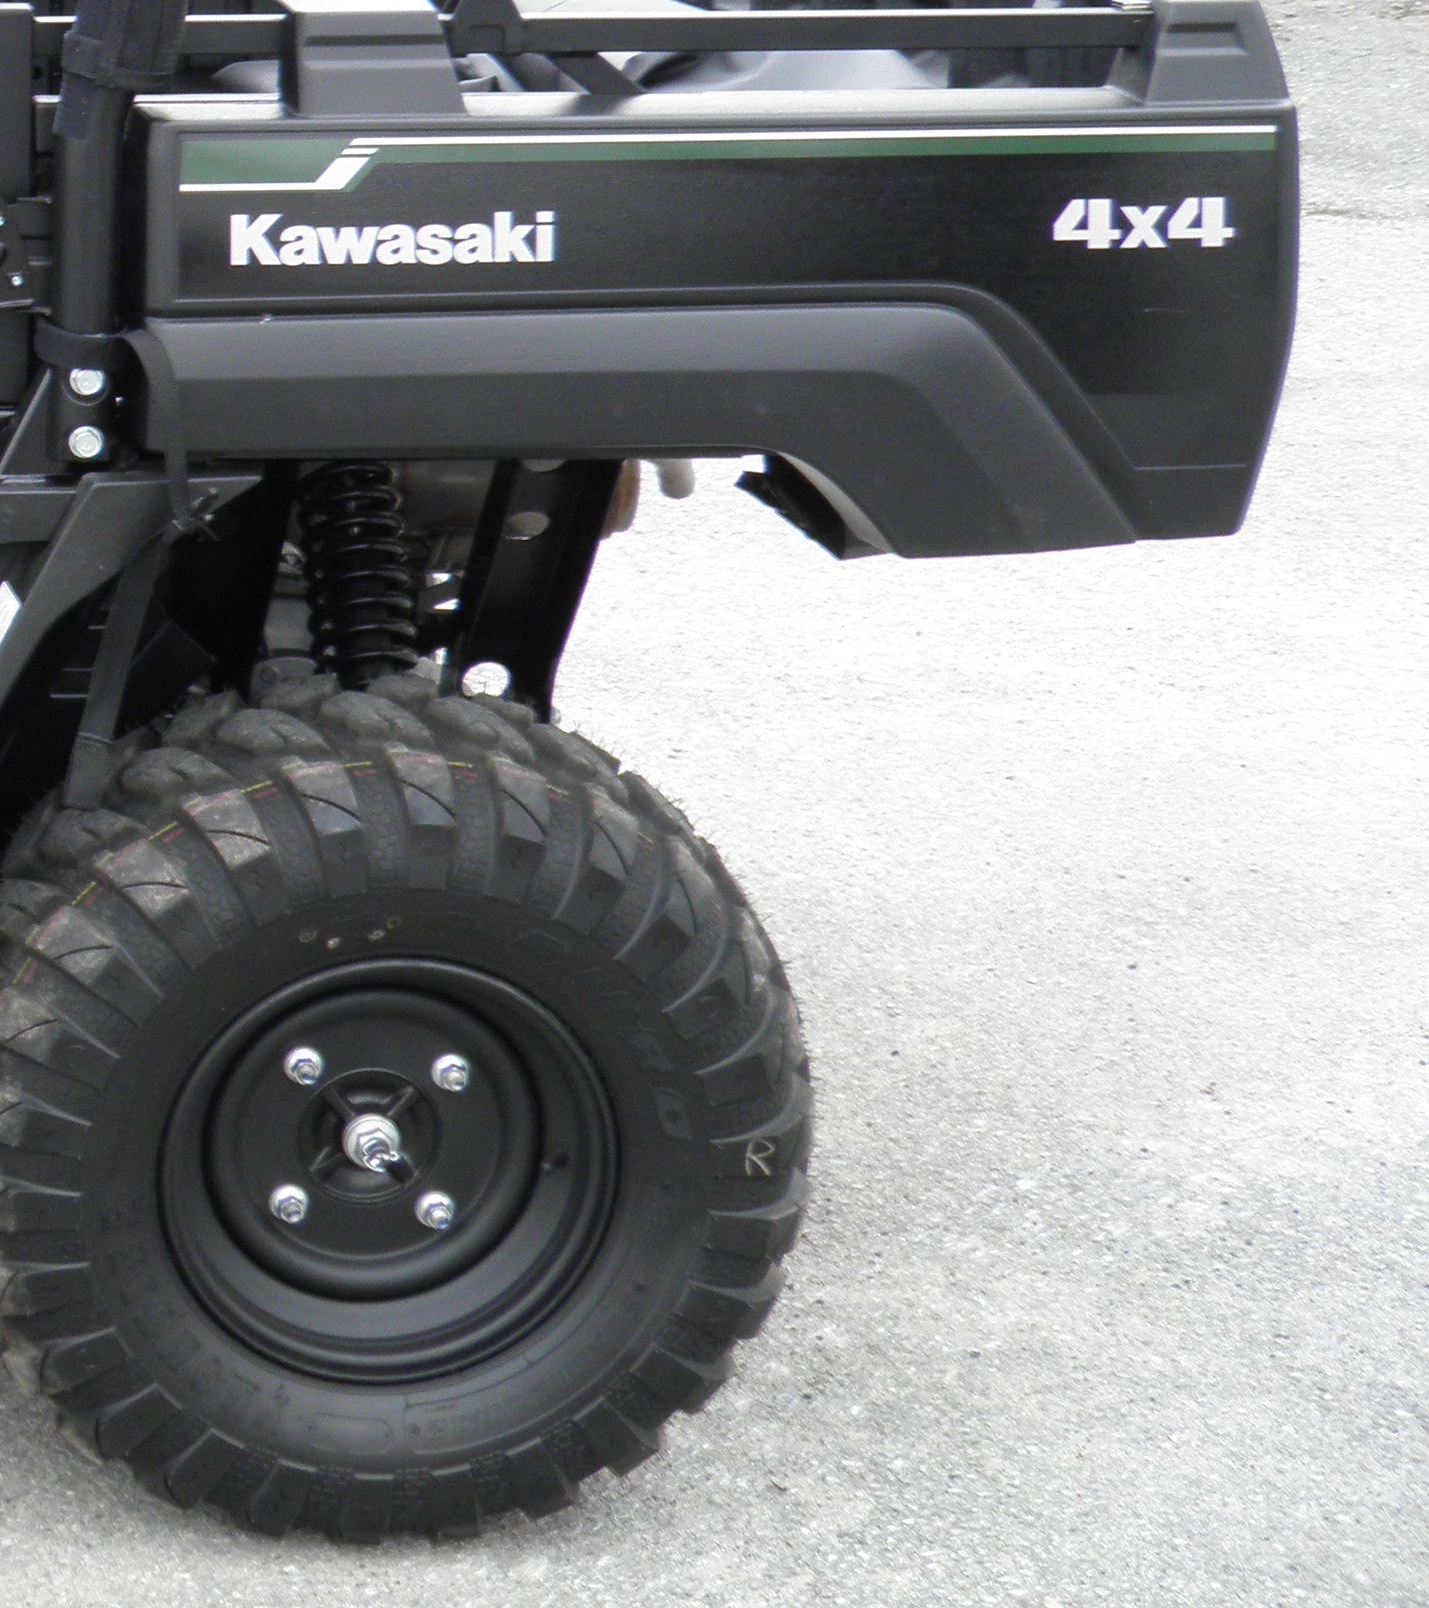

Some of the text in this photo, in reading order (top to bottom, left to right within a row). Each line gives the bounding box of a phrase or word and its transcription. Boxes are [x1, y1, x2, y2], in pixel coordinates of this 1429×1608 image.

[230, 210, 556, 266] Kawasaki
[1053, 197, 1236, 249] 4x4
[745, 1138, 776, 1177] R
